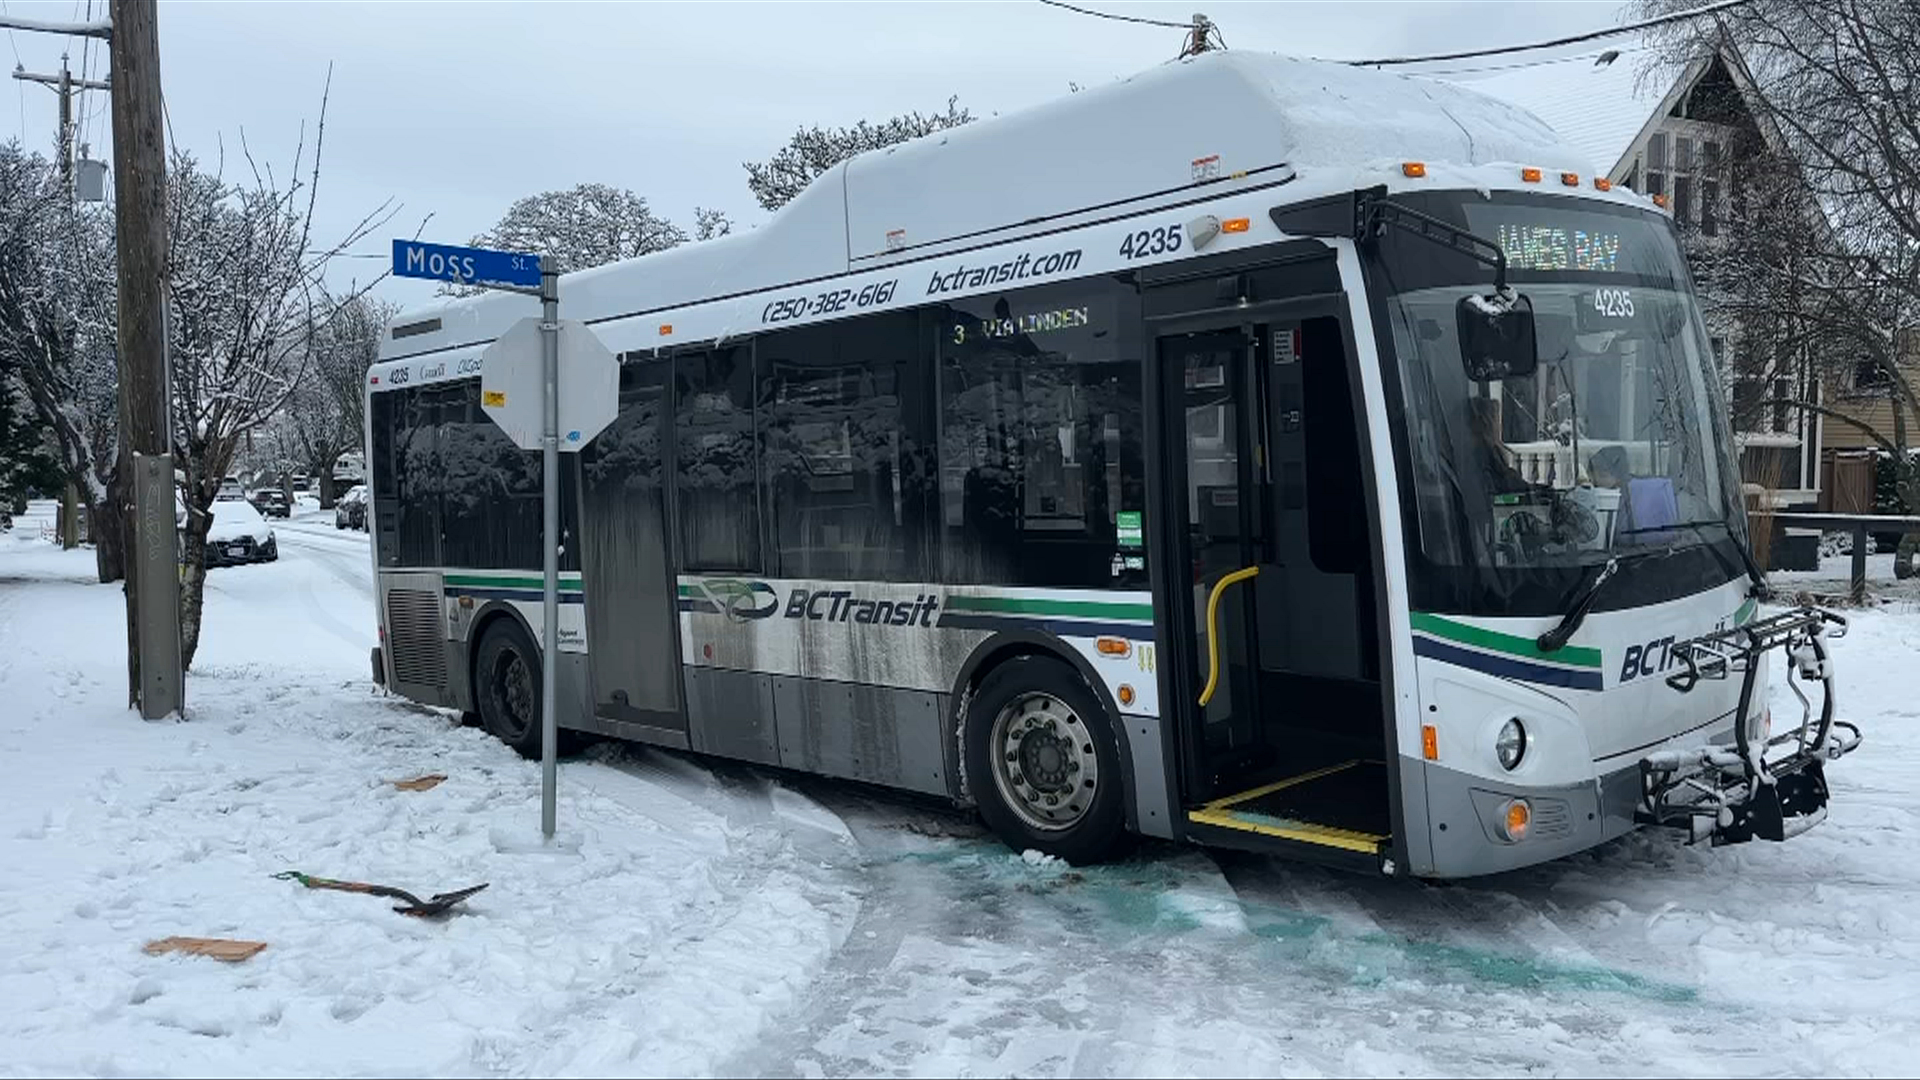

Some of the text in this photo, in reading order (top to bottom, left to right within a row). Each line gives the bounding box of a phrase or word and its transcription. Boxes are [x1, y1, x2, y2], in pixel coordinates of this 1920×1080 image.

[1118, 224, 1183, 261] 4235
[1575, 229, 1619, 272] BAY
[511, 255, 529, 271] St.
[926, 248, 1083, 296] bctransit.com
[1594, 288, 1635, 318] 4235
[953, 306, 1089, 345] 3 VIA LINDEN
[389, 366, 410, 384] 4235
[784, 588, 939, 628] BCTransit
